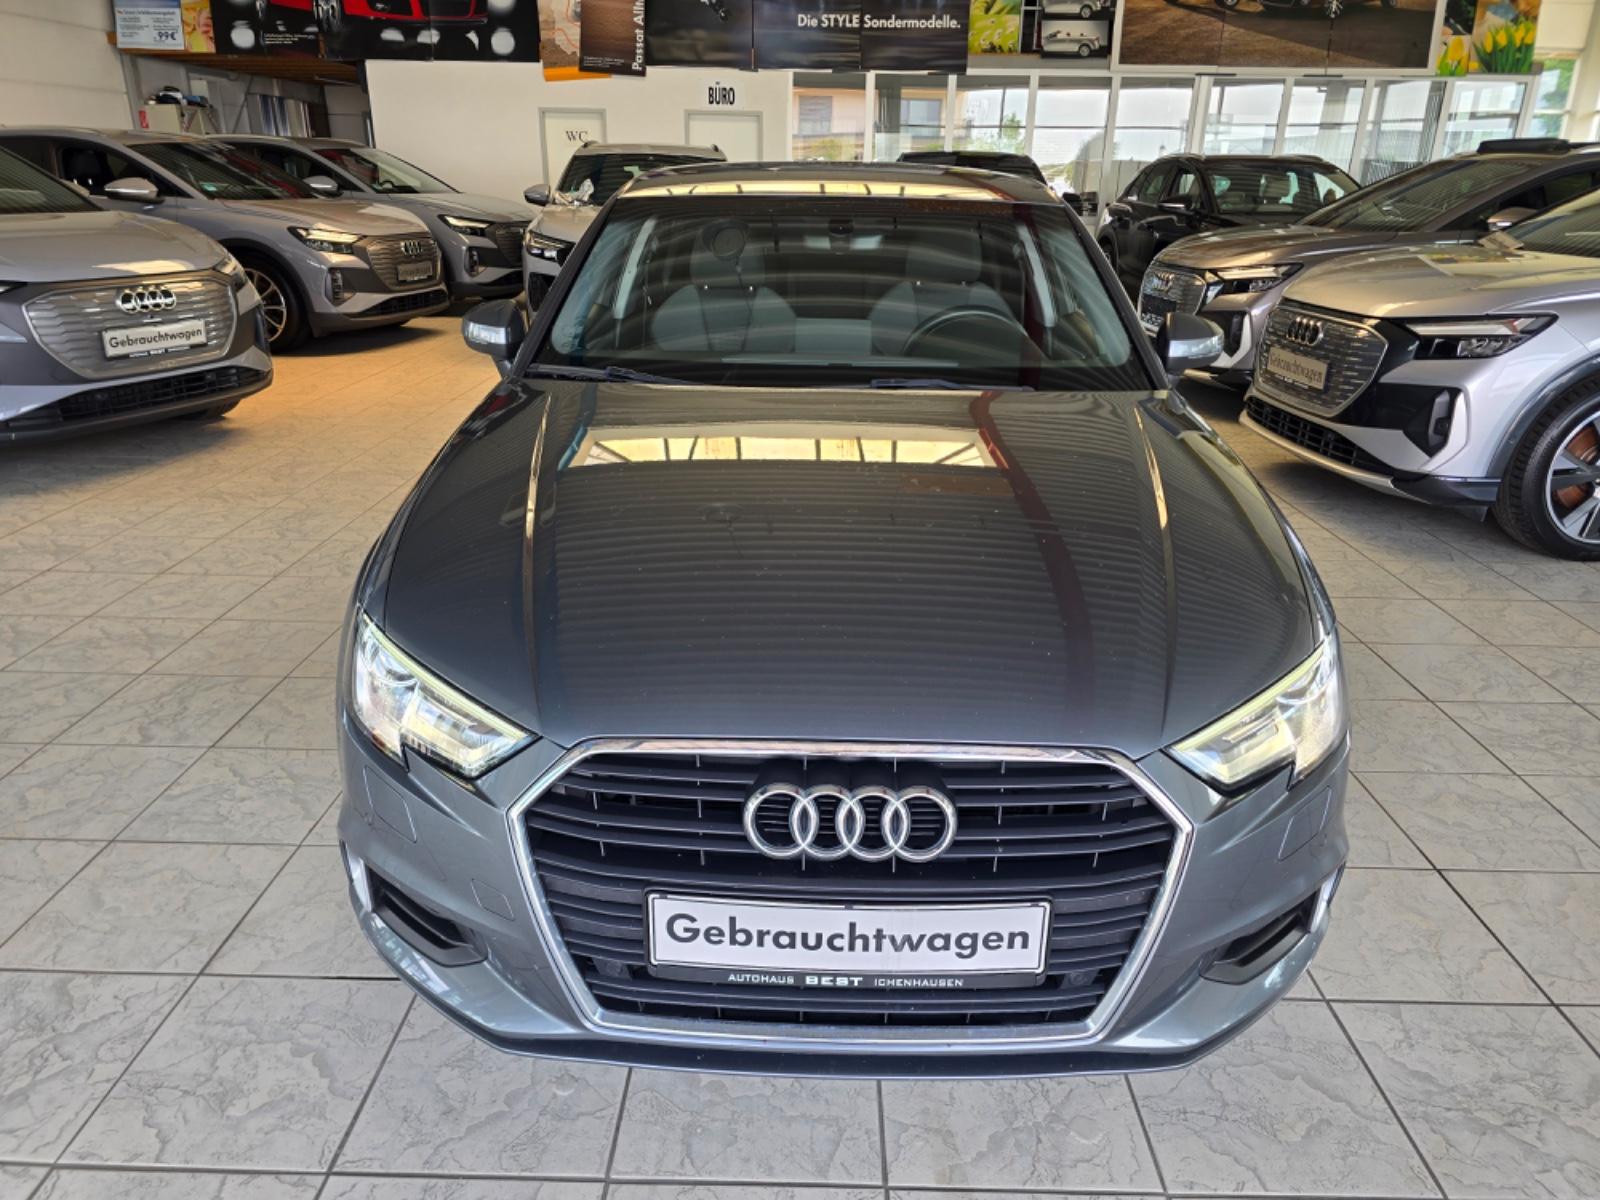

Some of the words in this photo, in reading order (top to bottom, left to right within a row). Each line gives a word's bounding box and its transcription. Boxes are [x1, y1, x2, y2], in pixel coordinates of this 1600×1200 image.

[797, 14, 818, 27] Die
[820, 14, 860, 28] STYLE
[864, 14, 961, 29] Sondermodelle.
[632, 28, 644, 71] Passat
[708, 82, 736, 105] BÜRO
[565, 130, 588, 143] WC
[109, 327, 203, 348] Gebrauchtwagen
[665, 912, 1030, 960] Gebrauchtwagen
[727, 973, 795, 985] AUTOHAUS
[805, 975, 864, 987] BEST
[873, 977, 964, 988] ICHENHAUSEN
